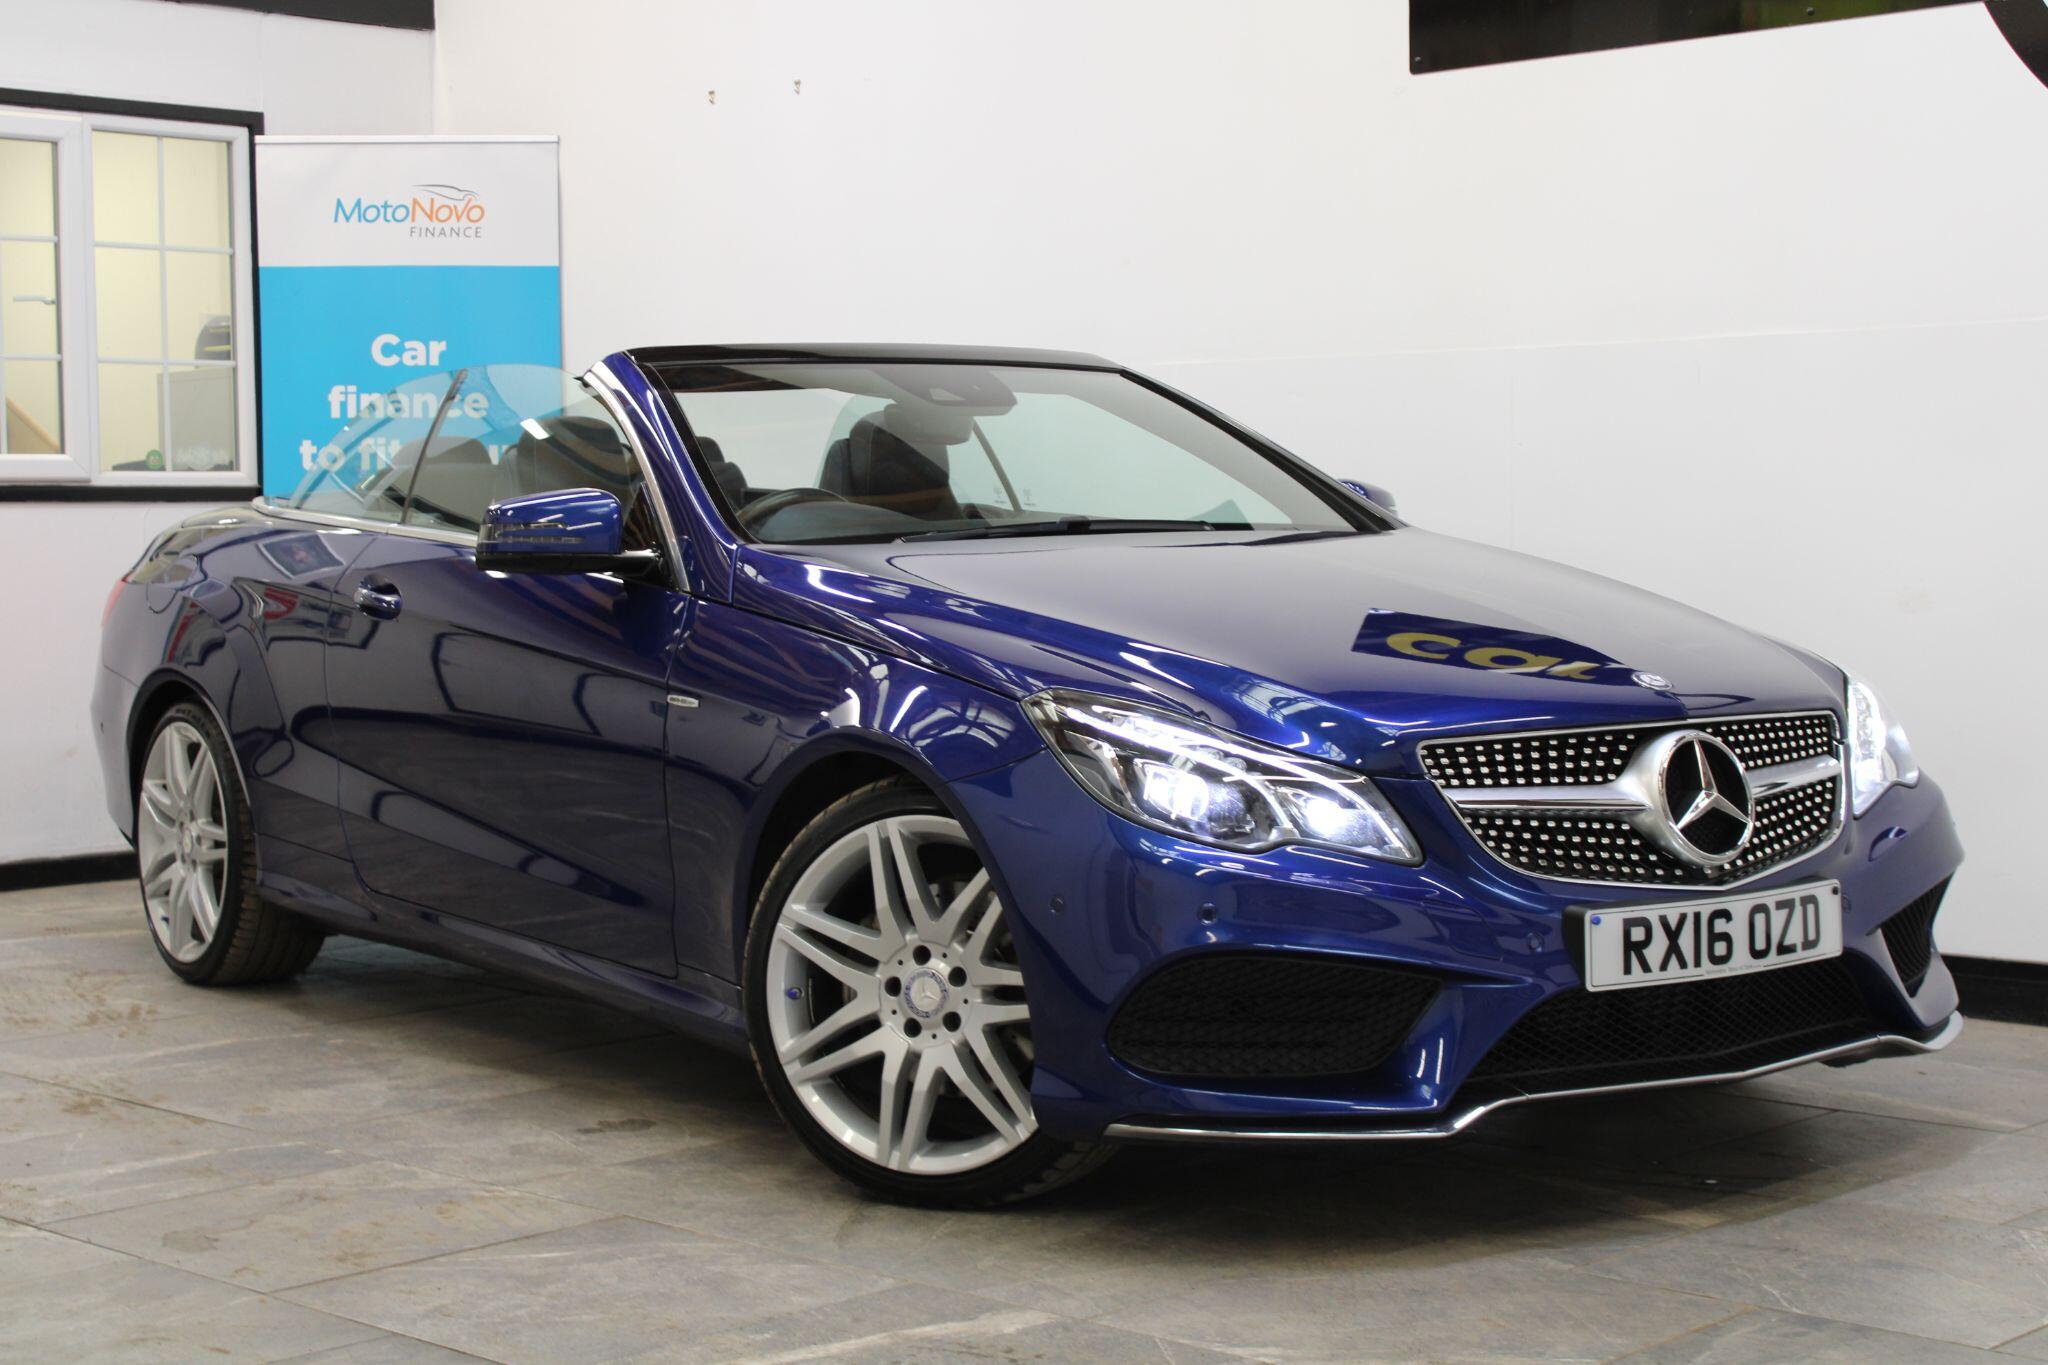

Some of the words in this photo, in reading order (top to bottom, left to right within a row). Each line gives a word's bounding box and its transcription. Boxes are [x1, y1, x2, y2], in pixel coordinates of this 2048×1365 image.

[333, 196, 485, 223] MotoNovo
[409, 226, 482, 238] FINANCE
[371, 333, 447, 367] Car
[299, 439, 346, 472] to
[1622, 908, 1733, 976] RX16
[1749, 894, 1821, 960] OZD
